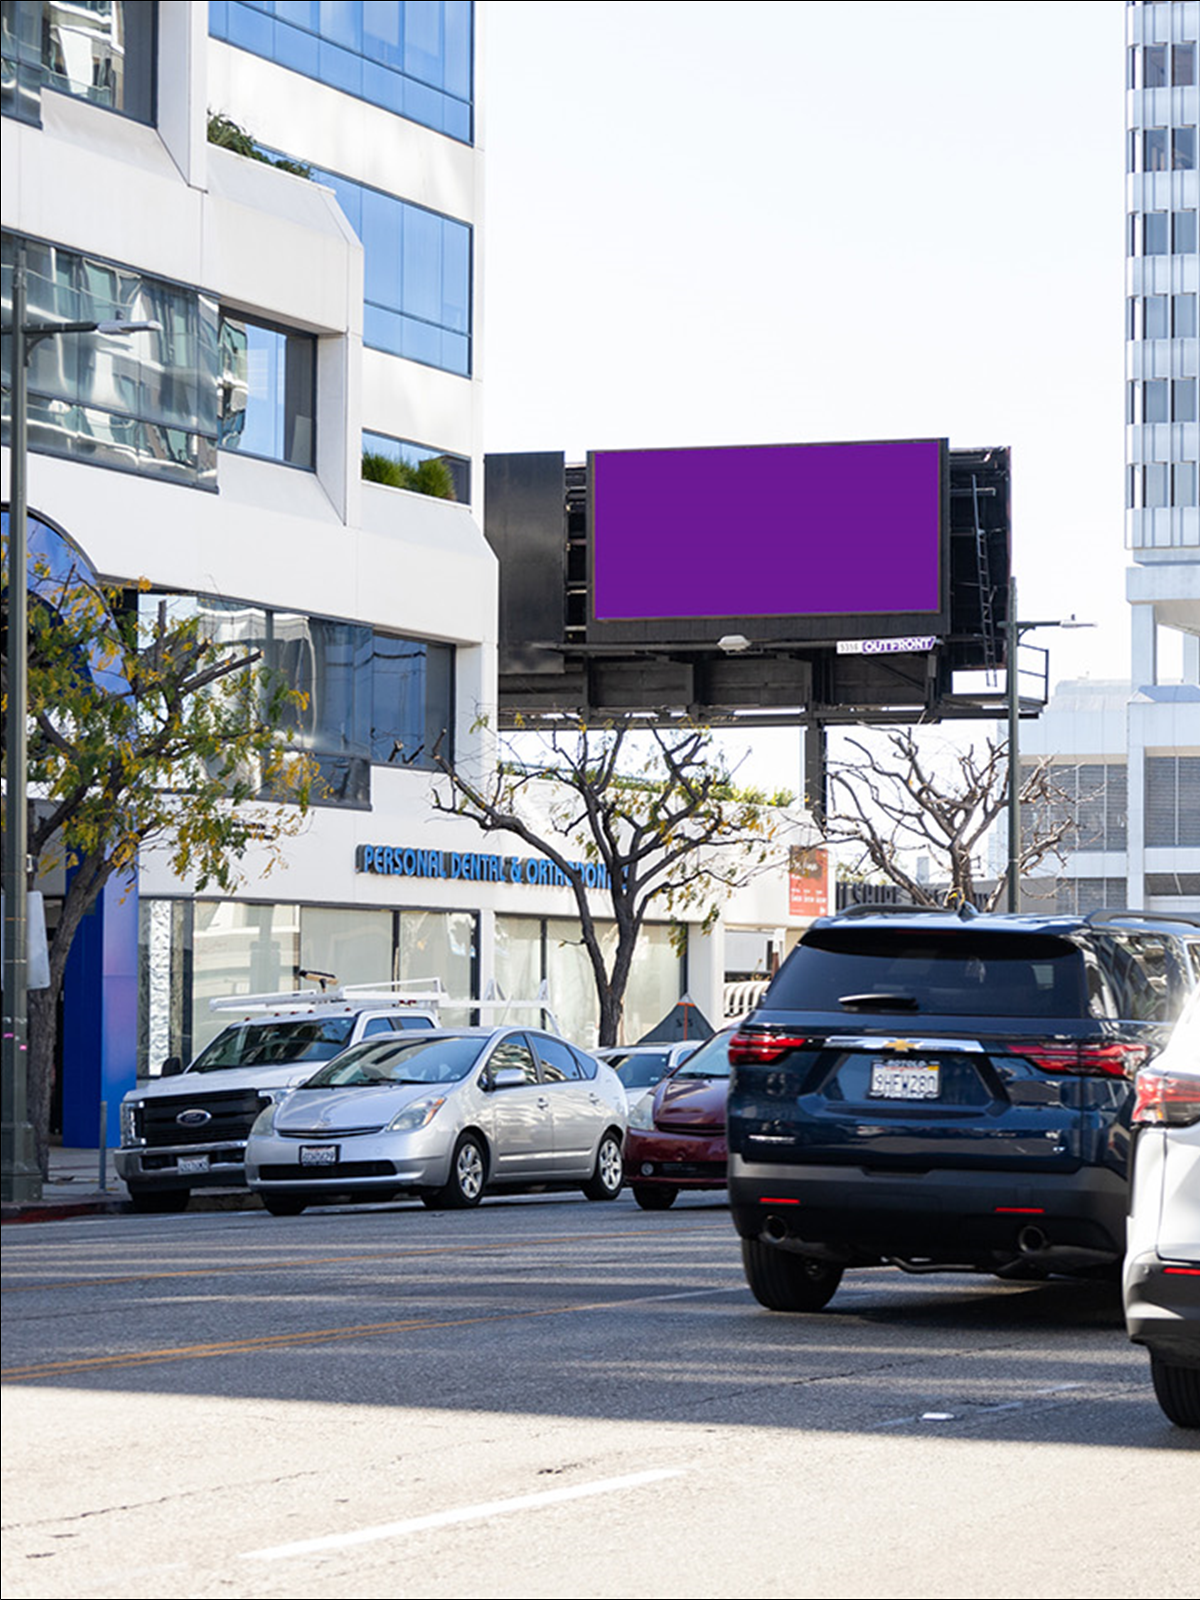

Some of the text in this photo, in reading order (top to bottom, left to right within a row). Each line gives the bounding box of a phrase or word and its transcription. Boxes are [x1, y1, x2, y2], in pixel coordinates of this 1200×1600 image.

[862, 636, 936, 655] OUTFRONT
[362, 844, 447, 879] PERSONAL
[450, 851, 505, 882] DENTAL
[510, 856, 522, 883] &
